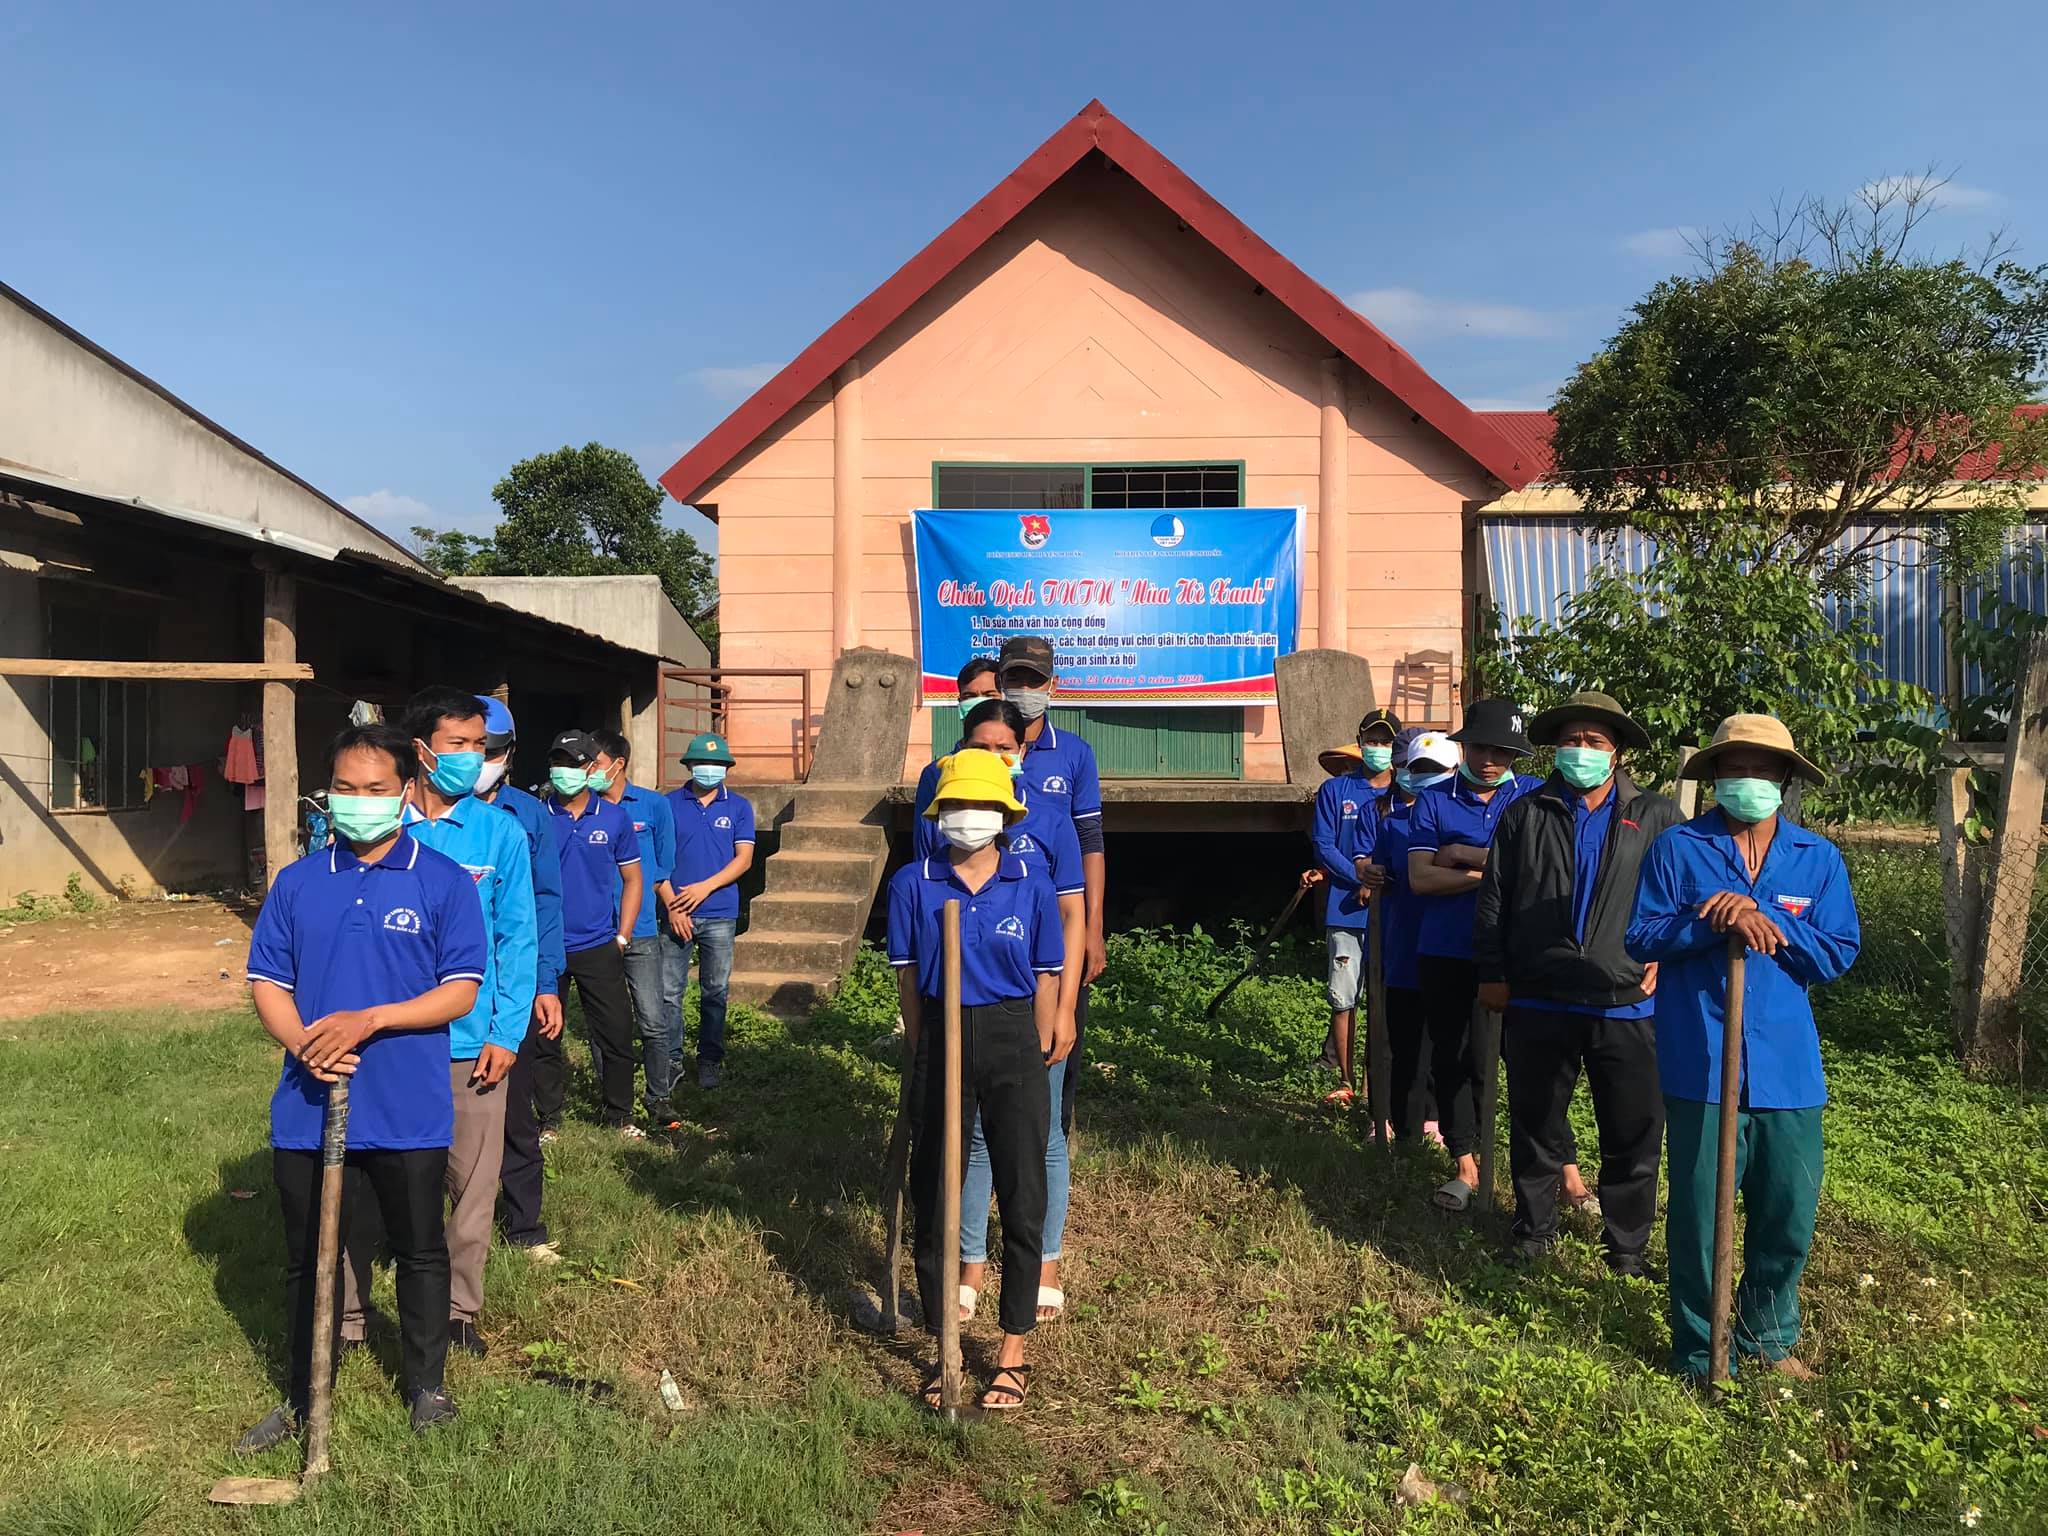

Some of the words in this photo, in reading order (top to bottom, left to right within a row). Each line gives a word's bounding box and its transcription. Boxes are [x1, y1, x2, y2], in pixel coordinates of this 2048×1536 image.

[937, 579, 986, 607] Chiến
[989, 579, 1035, 611] Dịch
[1120, 578, 1170, 606] "Mùa
[1175, 578, 1206, 605] Hè
[1210, 577, 1275, 605] Xanh"
[982, 616, 990, 628] Tu
[1009, 616, 1024, 628] nhà
[1026, 617, 1041, 628] văn
[1061, 617, 1082, 630] cộng
[1084, 615, 1106, 629] đồng
[972, 636, 981, 647] 2.
[983, 633, 993, 646] Ôn
[1059, 635, 1074, 647] các
[1077, 635, 1096, 648] hoạt
[1098, 635, 1119, 648] động
[1121, 634, 1133, 646] vui
[1136, 634, 1155, 646] chơi
[1158, 632, 1175, 648] giải
[1177, 632, 1187, 646] trí
[1188, 634, 1204, 646] cho
[1207, 633, 1231, 646] thanh
[1233, 631, 1255, 646] thiếu
[1257, 633, 1277, 647] niên
[1076, 655, 1087, 666] an
[1089, 653, 1107, 666] sinh
[1110, 655, 1120, 666] xã
[1122, 653, 1136, 668] hội
